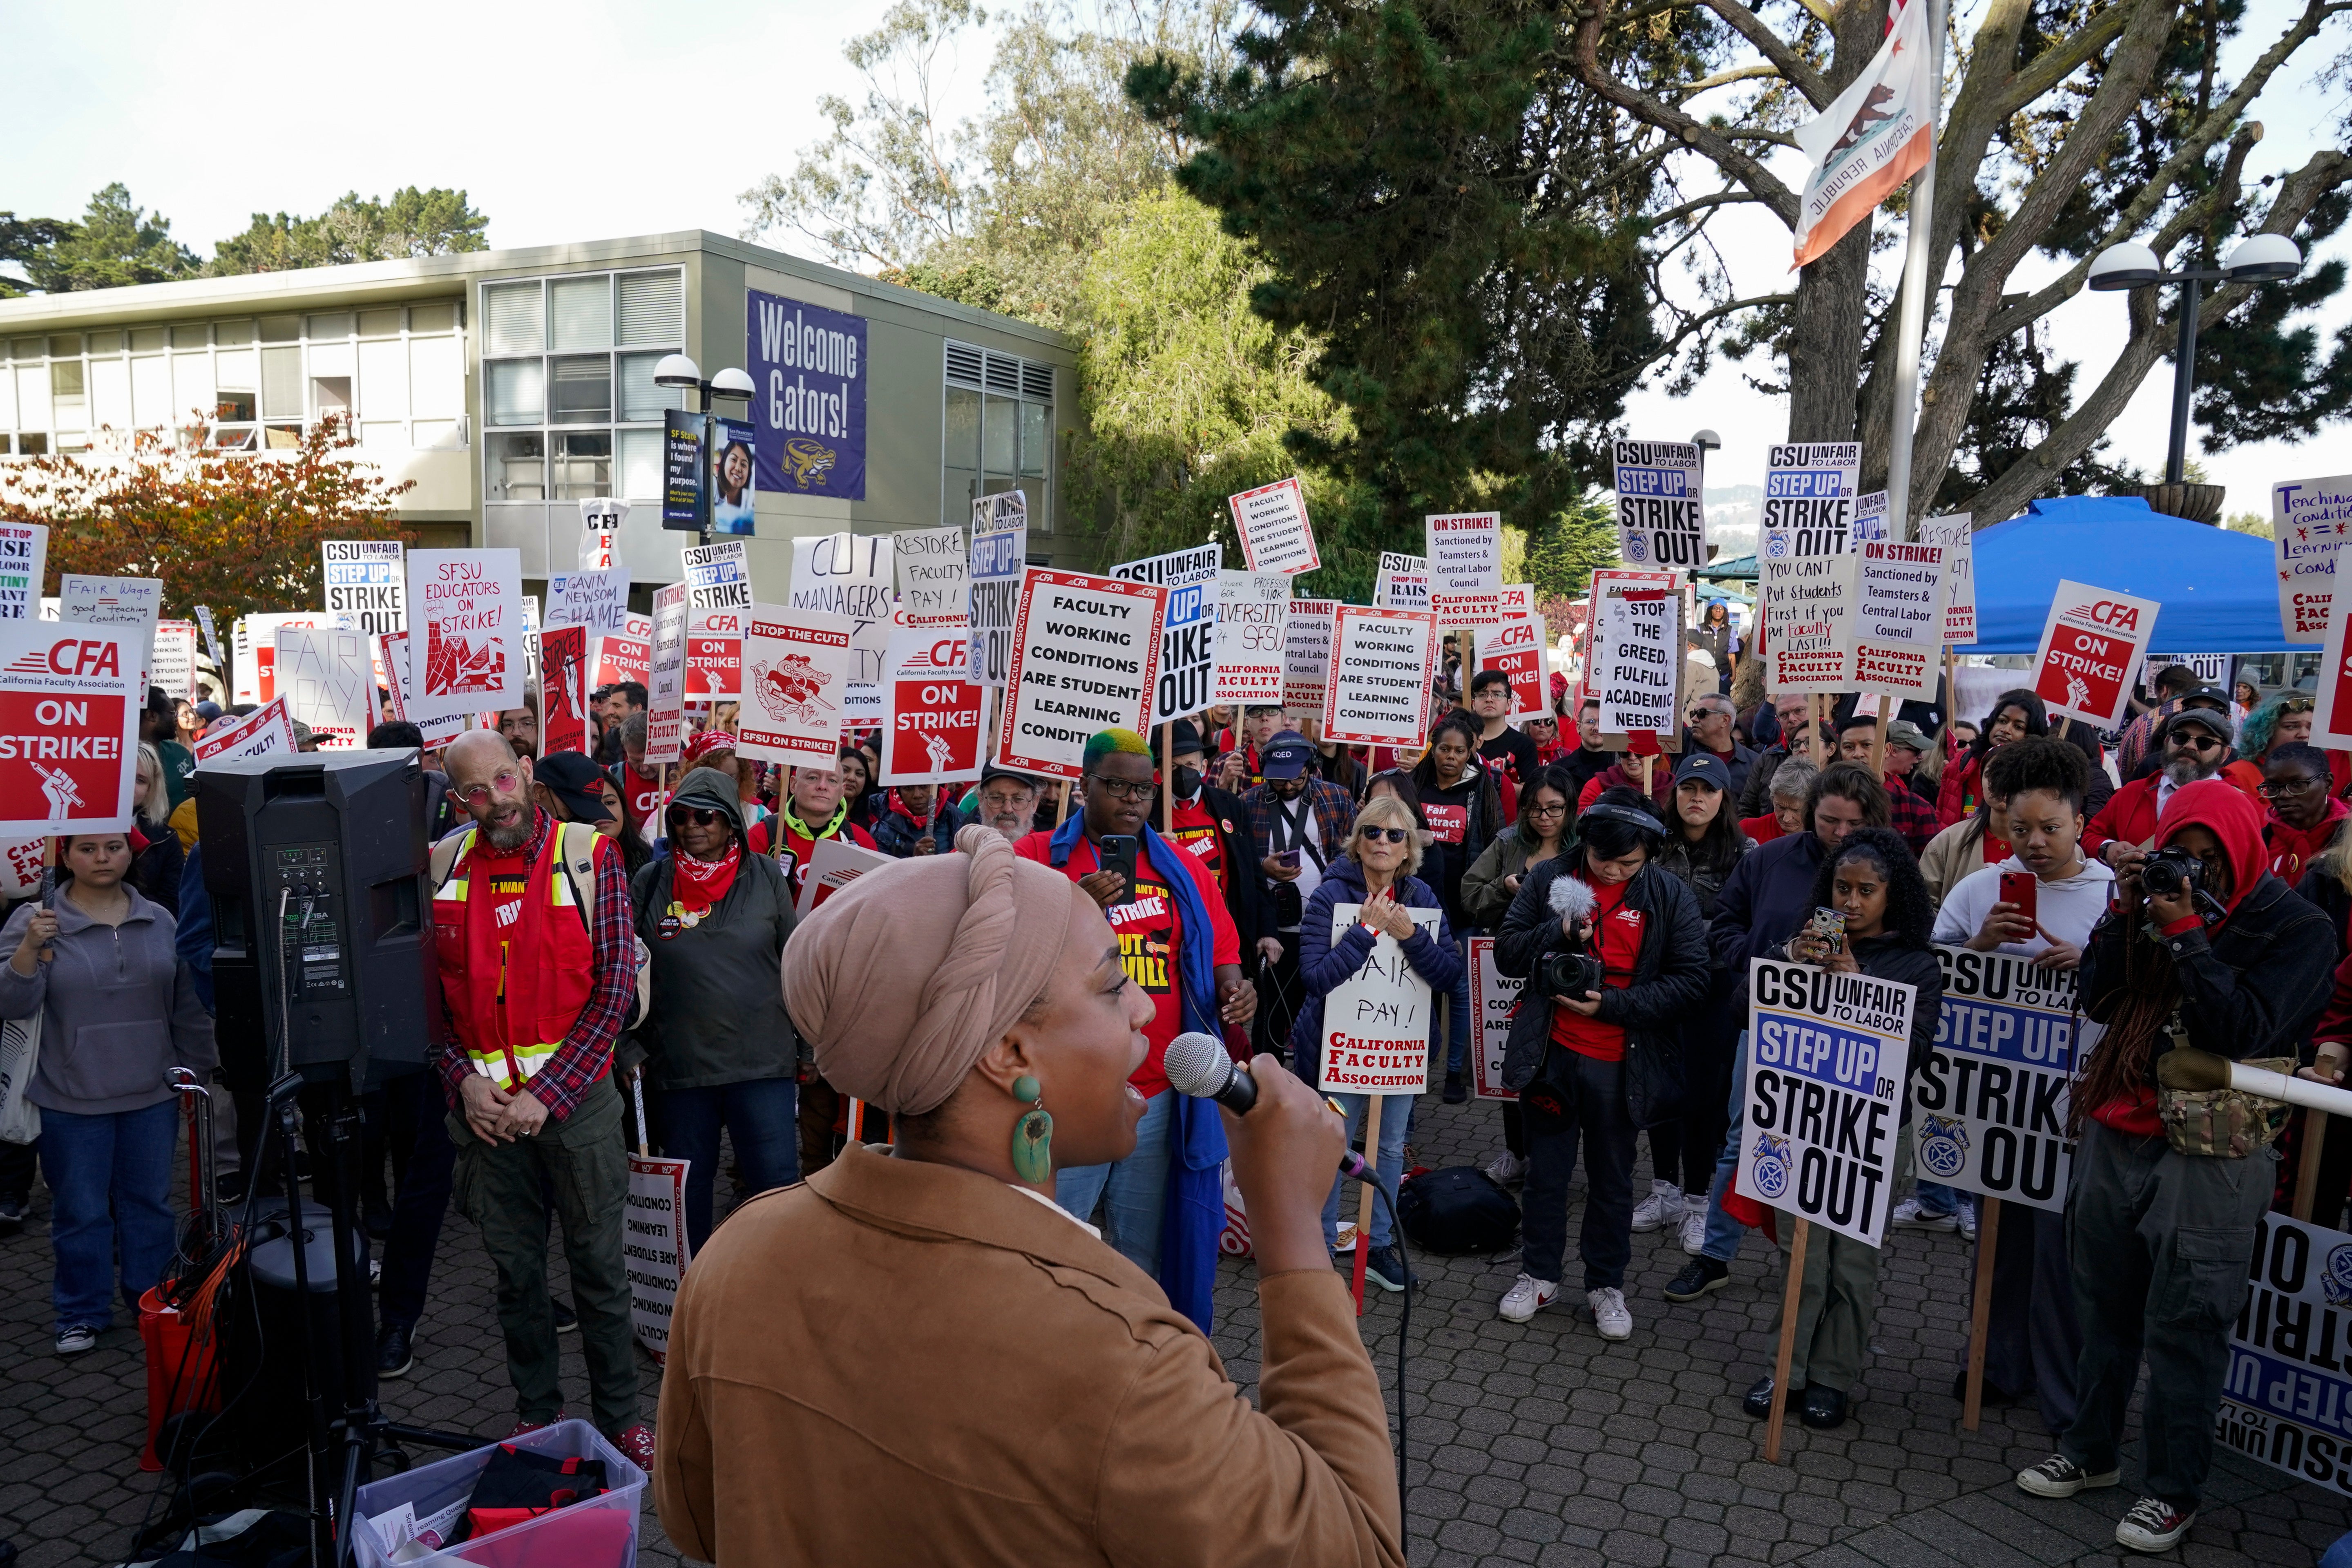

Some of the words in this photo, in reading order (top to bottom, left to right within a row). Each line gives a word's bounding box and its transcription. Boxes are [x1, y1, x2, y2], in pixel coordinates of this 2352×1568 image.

[759, 300, 857, 379] Welcome
[770, 369, 847, 439] Gators!
[681, 431, 697, 440] State
[671, 440, 676, 449] is
[678, 442, 696, 451] where
[675, 453, 692, 462] found
[670, 465, 681, 474] my
[670, 477, 697, 486] purpose.
[1249, 494, 1284, 508] FACULTY
[587, 514, 618, 530] CFA
[1251, 505, 1289, 520] WORKING
[1249, 514, 1298, 533] CONDITIONS
[1434, 519, 1448, 531] ON
[1451, 517, 1492, 530] STRIKE!
[894, 533, 963, 555] RESTORE
[1250, 534, 1266, 545] ARE
[1268, 525, 1303, 541] STUDENT
[1435, 536, 1479, 546] Sanctioned
[1481, 536, 1492, 547] by
[327, 543, 360, 560] CSU
[363, 543, 399, 554] UNFAIR
[811, 534, 888, 577] CUT
[1259, 539, 1299, 554] LEARNING
[1439, 551, 1480, 560] Teamsters
[1258, 548, 1307, 567] CONDITIONS
[330, 564, 367, 583] STEP
[370, 564, 389, 583] UP
[438, 562, 482, 581] SFSU
[909, 564, 963, 581] FACULTY
[1437, 565, 1467, 574] Central
[1469, 564, 1491, 572] Labor
[1768, 563, 1791, 581] YOU
[120, 583, 152, 596] Wage
[426, 582, 500, 599] EDUCATORS
[568, 573, 607, 590] GAVIN
[1254, 578, 1290, 588] PROFESSOR
[1450, 579, 1479, 587] Council
[1791, 581, 1842, 600] Students
[331, 587, 400, 610] STRIKE
[565, 587, 616, 604] NEWSOM
[656, 591, 664, 610] ON
[664, 583, 686, 607] STRIKE!
[793, 585, 889, 619] MANAGERS
[1260, 590, 1285, 600] $110K
[1432, 594, 1499, 604] CALIFORNIA
[72, 604, 96, 615] good
[107, 604, 148, 617] teaching
[458, 600, 474, 611] ON
[1053, 596, 1131, 619] FACULTY
[1432, 605, 1498, 613] FACULTY
[1631, 603, 1665, 615] STOP
[1767, 606, 1798, 623] First
[1806, 604, 1817, 619] if
[1823, 606, 1843, 624] you
[361, 612, 401, 637] OUT
[442, 605, 502, 633] STRIKE!
[549, 605, 626, 630] SHAME
[655, 613, 677, 632] Sanctioned
[678, 612, 683, 628] by
[1015, 591, 1031, 650] ASSOCIATION
[2090, 601, 2139, 631] CFA
[753, 623, 786, 637] STOP
[788, 628, 811, 641] THE
[813, 632, 847, 646] CUTS
[1046, 622, 1130, 646] WORKING
[1359, 624, 1413, 636] FACULTY
[1633, 623, 1660, 640] THE
[1788, 622, 1832, 638] Faculty
[2059, 615, 2084, 625] California
[2085, 621, 2104, 631] Faculty
[2105, 625, 2137, 639] Association
[656, 637, 675, 653] Teamsters
[676, 634, 680, 646] &
[1243, 625, 1286, 651] SFSU
[1355, 641, 1414, 653] WORKING
[1788, 638, 1831, 651] LAST!!!
[2075, 635, 2109, 656] ON
[48, 639, 120, 677] CFA
[279, 631, 357, 677] FAIR
[541, 625, 581, 674] STRIKE!
[1619, 644, 1668, 666] GREED,
[654, 659, 668, 673] Central
[669, 657, 680, 671] Labor
[1032, 646, 1139, 674] CONDITIONS
[1345, 657, 1420, 671] CONDITIONS
[2047, 650, 2123, 682] STRIKE!
[1010, 651, 1021, 690] FACULTY
[1614, 666, 1669, 687] FULFILL
[44, 678, 76, 689] Faculty
[78, 679, 125, 689] Association
[658, 681, 672, 695] Council
[1022, 671, 1057, 687] ARE
[1061, 677, 1141, 701] STUDENT
[1339, 675, 1364, 683] ARE
[1367, 677, 1422, 689] STUDENT
[296, 679, 357, 723] PAY
[921, 686, 956, 704] ON
[1349, 693, 1409, 705] LEARNING
[1605, 689, 1673, 708] ACADEMIC
[35, 701, 87, 726] ON
[649, 708, 680, 723] CALIFORNIA
[897, 710, 978, 730] STRIKE!
[1003, 691, 1016, 744] CALIFORNIA
[1034, 698, 1121, 724] LEARNING
[1340, 709, 1414, 723] CONDITIONS
[1615, 712, 1665, 728] NEEDS!
[649, 725, 679, 739] FACULTY
[744, 732, 771, 744] SFSU
[773, 735, 788, 746] ON
[791, 737, 834, 751] STRIKE!
[0, 736, 119, 760] STRIKE!
[646, 739, 678, 755] ASSOCIATION
[1272, 750, 1291, 758] KQED
[1756, 965, 1832, 1016] CSU
[1834, 977, 1907, 1016] UNFAIR
[1833, 1004, 1851, 1019] TO
[1854, 1012, 1903, 1035] LABOR
[1329, 1032, 1425, 1051] CALIFORNIA
[1329, 1050, 1423, 1068] FACULTY
[1760, 1021, 1832, 1072] STEP
[1835, 1038, 1876, 1087] UP
[1876, 1077, 1894, 1101] OR
[1325, 1067, 1423, 1086] ASSOCIATION
[1752, 1070, 1889, 1166] STRIKE
[1798, 1146, 1883, 1235] OUT
